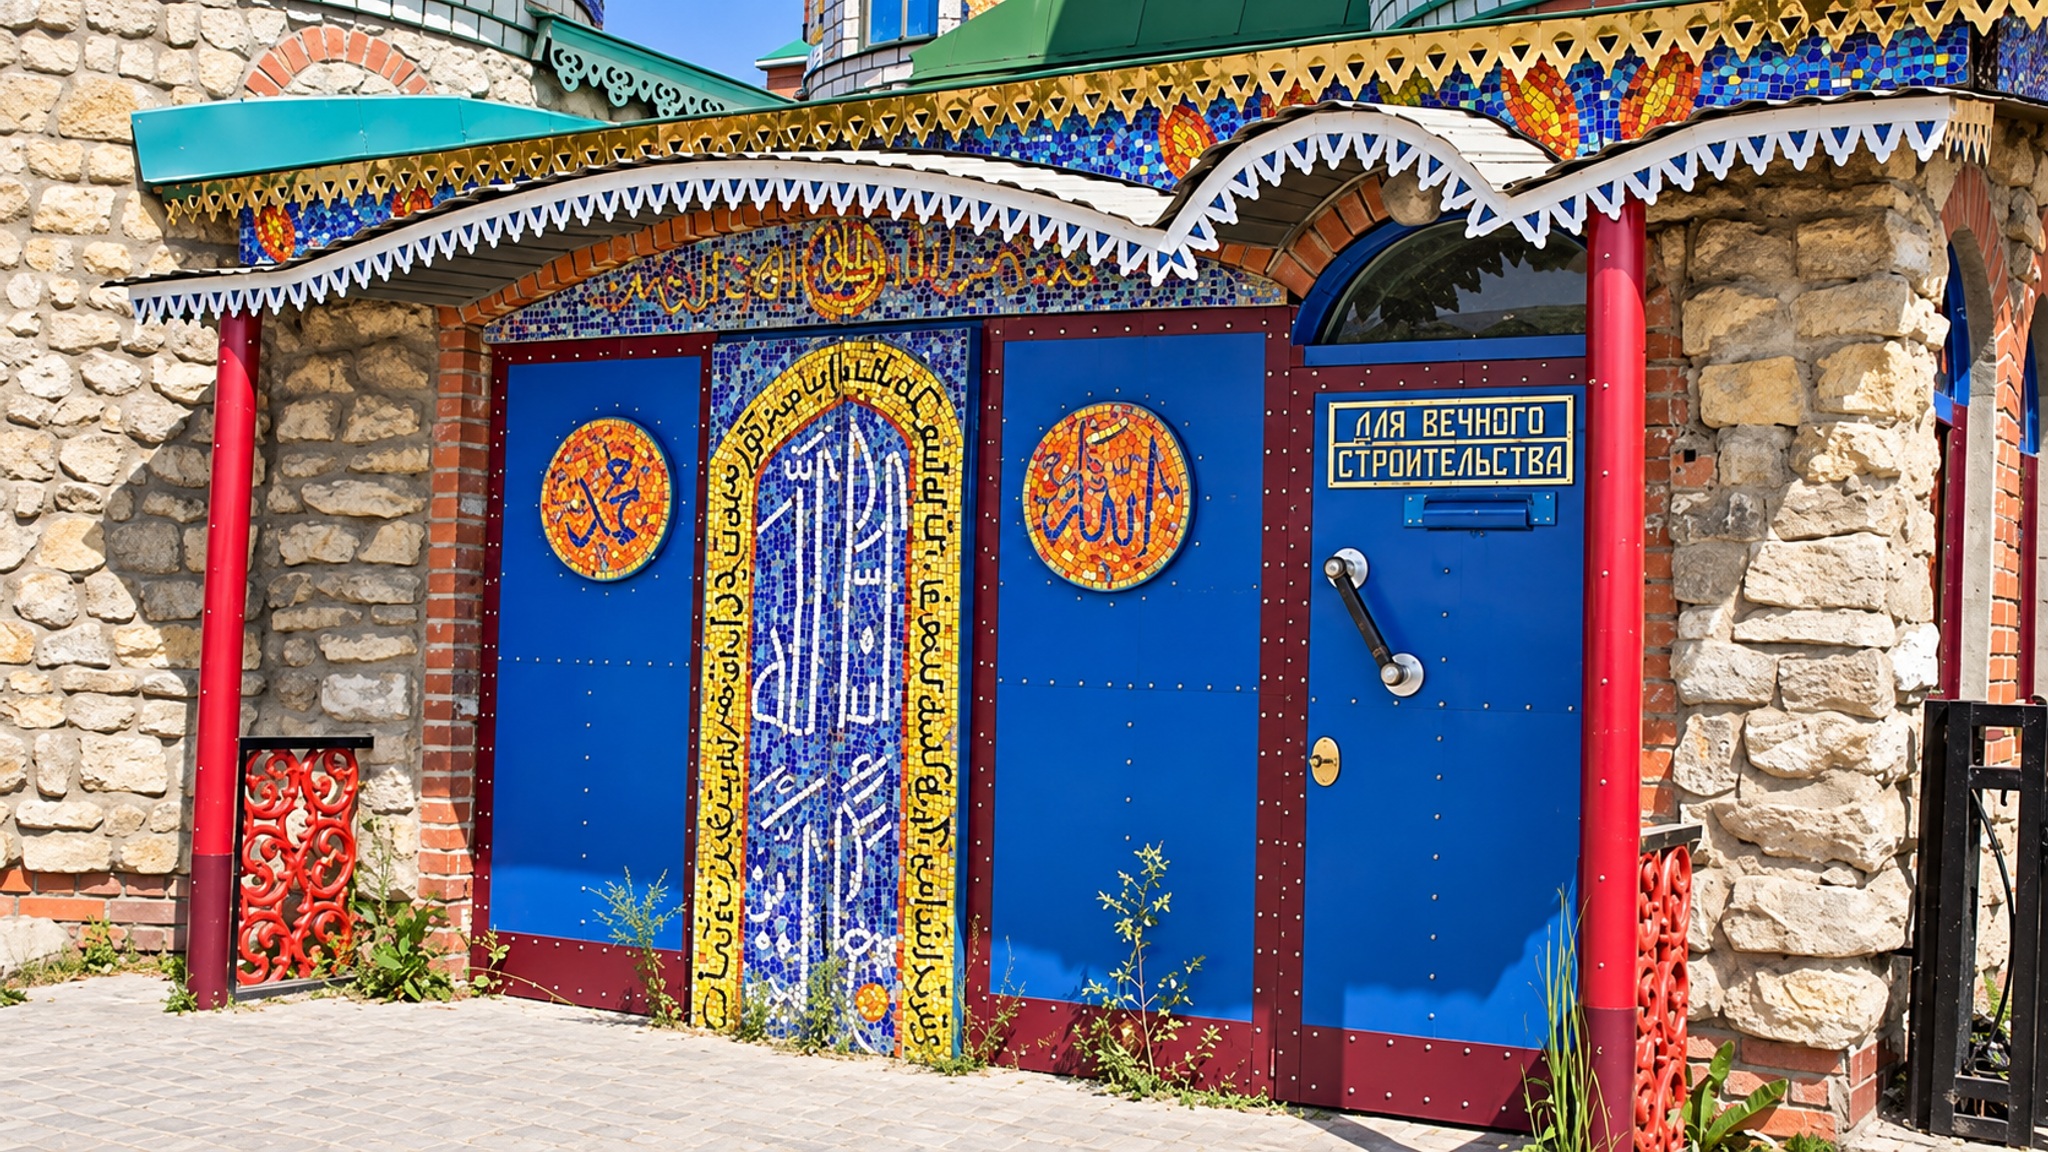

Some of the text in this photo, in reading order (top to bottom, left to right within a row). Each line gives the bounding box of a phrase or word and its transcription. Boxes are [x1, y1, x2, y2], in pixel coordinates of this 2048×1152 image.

[1354, 406, 1544, 443] ДЛЯ ВЕЧНОГО
[1338, 446, 1562, 478] СТРОИТЕЛЬСТВА
